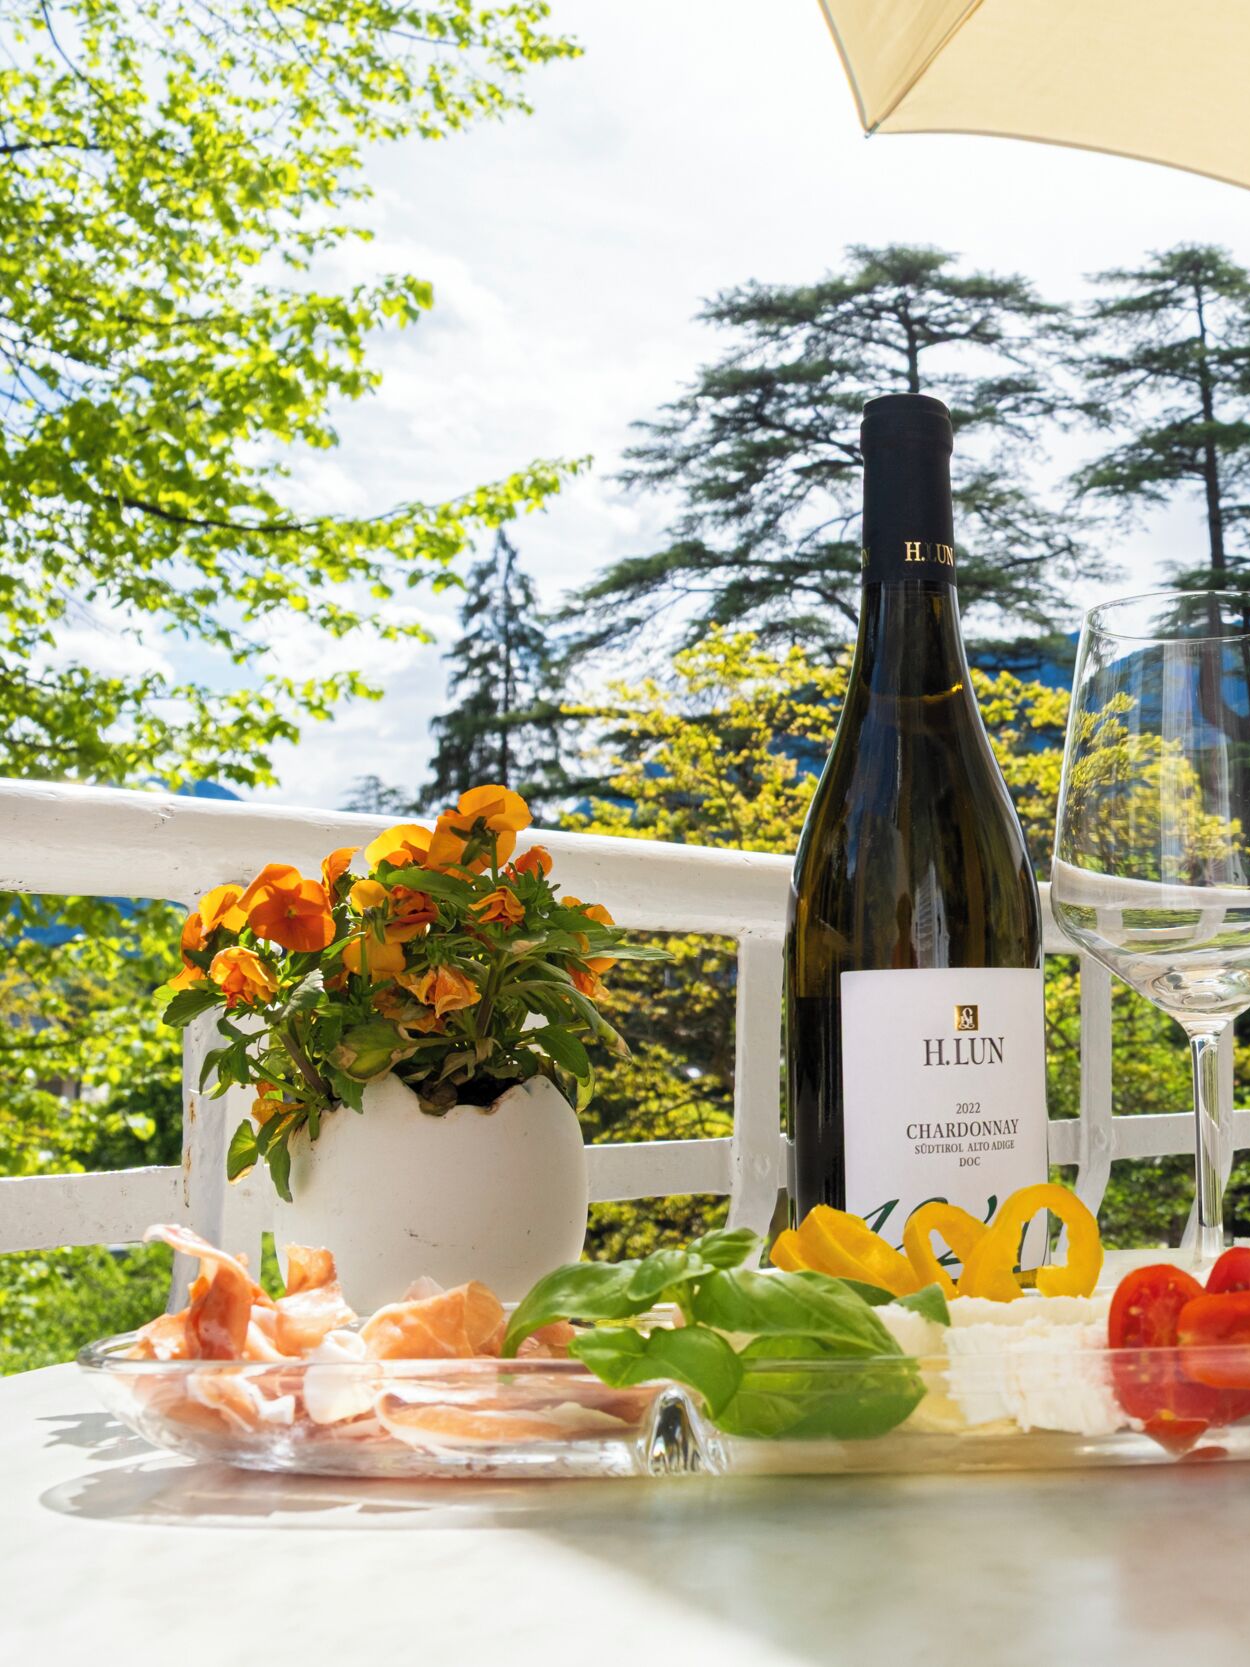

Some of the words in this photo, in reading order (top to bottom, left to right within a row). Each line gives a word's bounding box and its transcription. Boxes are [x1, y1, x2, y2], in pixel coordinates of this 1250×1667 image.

[955, 1102, 981, 1114] 2022
[906, 1119, 1019, 1140] CHARDONNAY
[914, 1142, 964, 1155] SÜDTIROL
[967, 1141, 990, 1152] ALTO
[991, 1139, 1015, 1151] ADIGE
[959, 1156, 981, 1167] DOC
